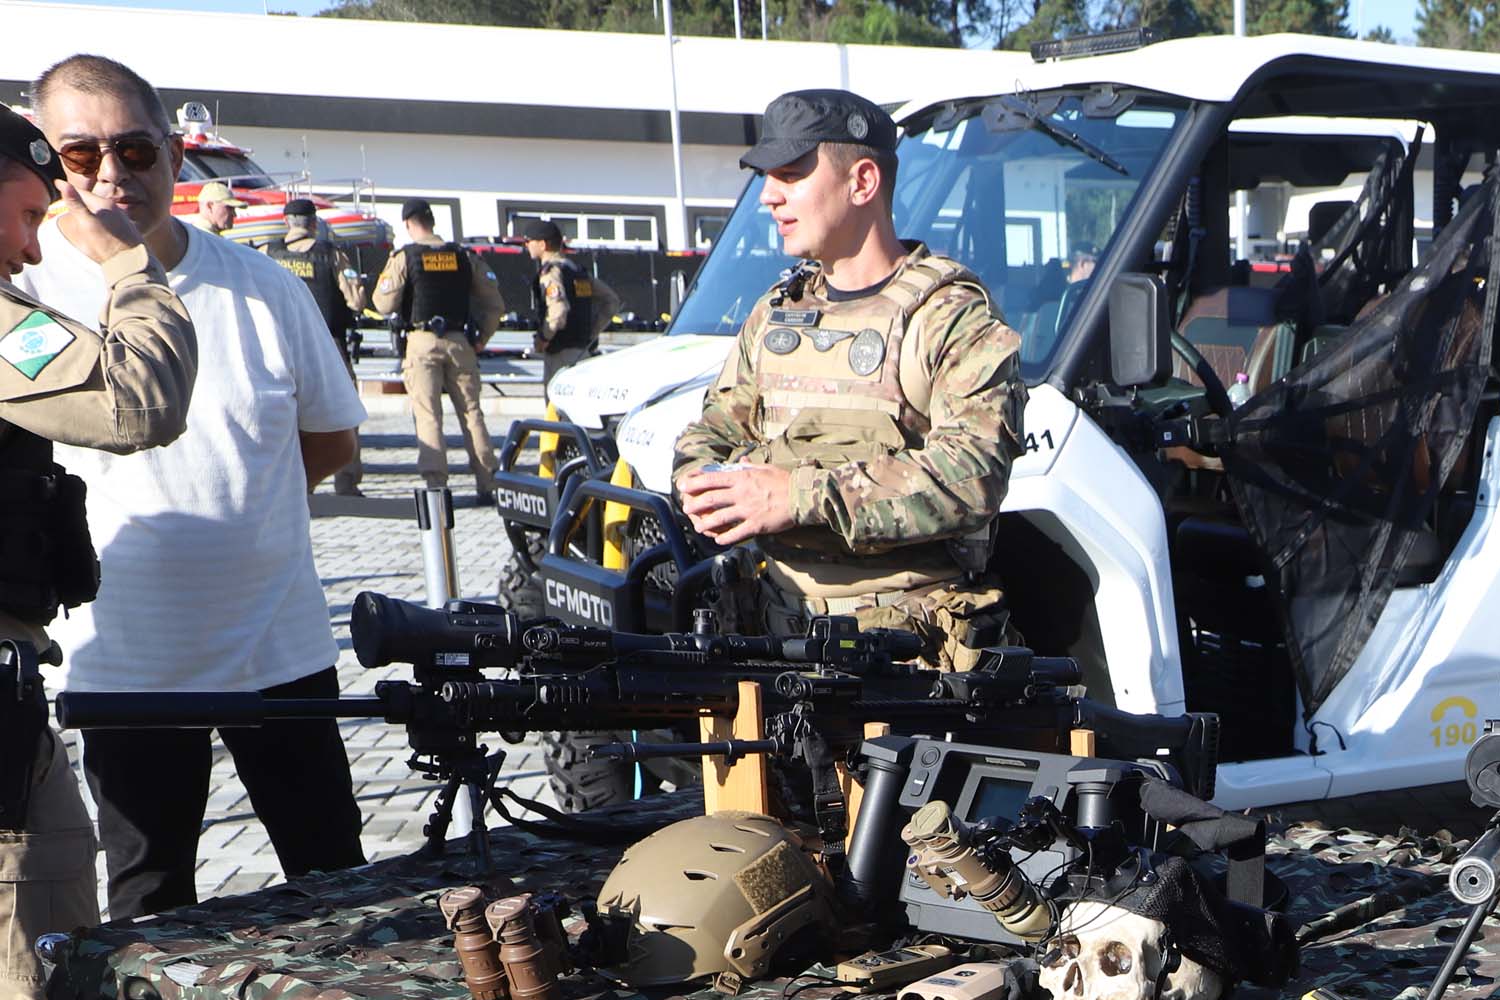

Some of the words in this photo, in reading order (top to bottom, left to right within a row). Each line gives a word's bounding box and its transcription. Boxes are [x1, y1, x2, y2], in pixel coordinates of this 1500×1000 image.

[497, 488, 547, 517] CFMOTO
[545, 579, 613, 626] CFMOTO
[1430, 721, 1477, 748] 190
